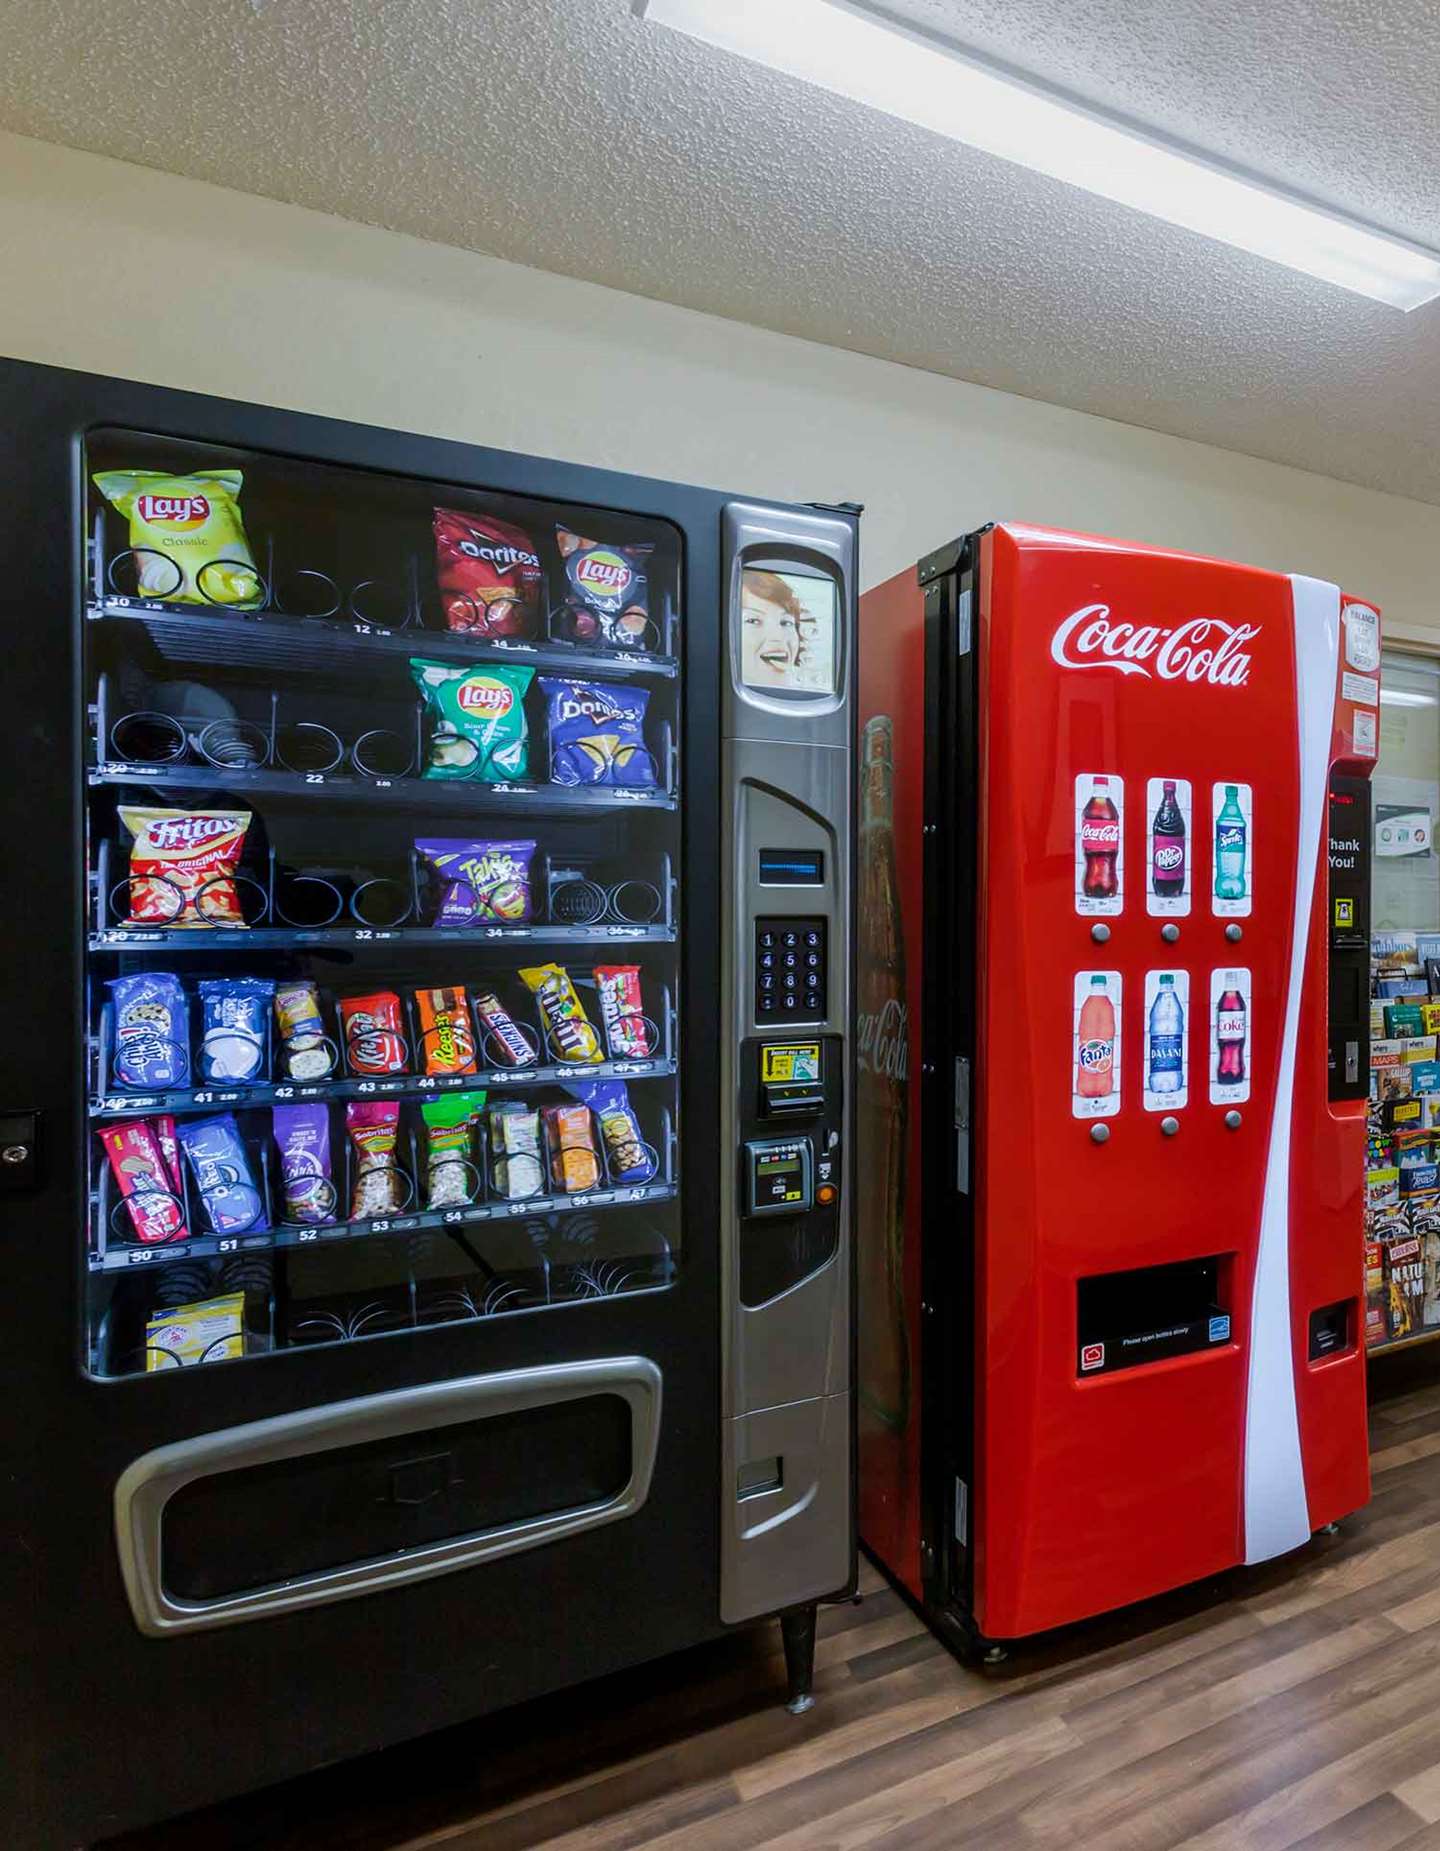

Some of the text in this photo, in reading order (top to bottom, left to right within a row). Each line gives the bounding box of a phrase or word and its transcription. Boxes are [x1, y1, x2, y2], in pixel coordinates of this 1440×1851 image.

[144, 496, 207, 522] Lay's
[162, 536, 209, 547] Classic
[459, 540, 541, 569] Doritos
[582, 561, 628, 585] Lay's
[355, 624, 371, 634] 12
[1051, 604, 1264, 687] Coca-Cola
[463, 686, 512, 709] Lay's
[562, 699, 638, 722] Doritos
[305, 774, 325, 784] 22
[147, 814, 240, 847] Fritos
[1082, 823, 1120, 842] Coca-Cola
[1220, 831, 1244, 848] Sprite
[1327, 855, 1355, 869] You!
[355, 930, 373, 939] 32
[764, 933, 772, 945] 1
[786, 933, 795, 945] 2
[808, 933, 817, 945] 3
[764, 954, 772, 966] 4
[786, 954, 795, 966] 5
[808, 954, 817, 966] 6
[764, 975, 772, 987] 7
[786, 975, 795, 987] 8
[808, 975, 817, 987] 9
[786, 996, 794, 1007] 0
[432, 1014, 457, 1066] Reese's
[490, 1013, 531, 1058] SNICKERS
[1373, 1056, 1399, 1066] MAPS
[418, 1078, 435, 1088] 44
[492, 1072, 508, 1082] 45
[275, 1087, 294, 1098] 42
[358, 1082, 376, 1092] 43
[194, 1092, 213, 1103] 41
[510, 1203, 527, 1213] 55
[446, 1212, 463, 1222] 54
[372, 1220, 389, 1232] 53
[299, 1230, 318, 1241] 52
[219, 1239, 238, 1251] 51
[131, 1250, 153, 1262] 50
